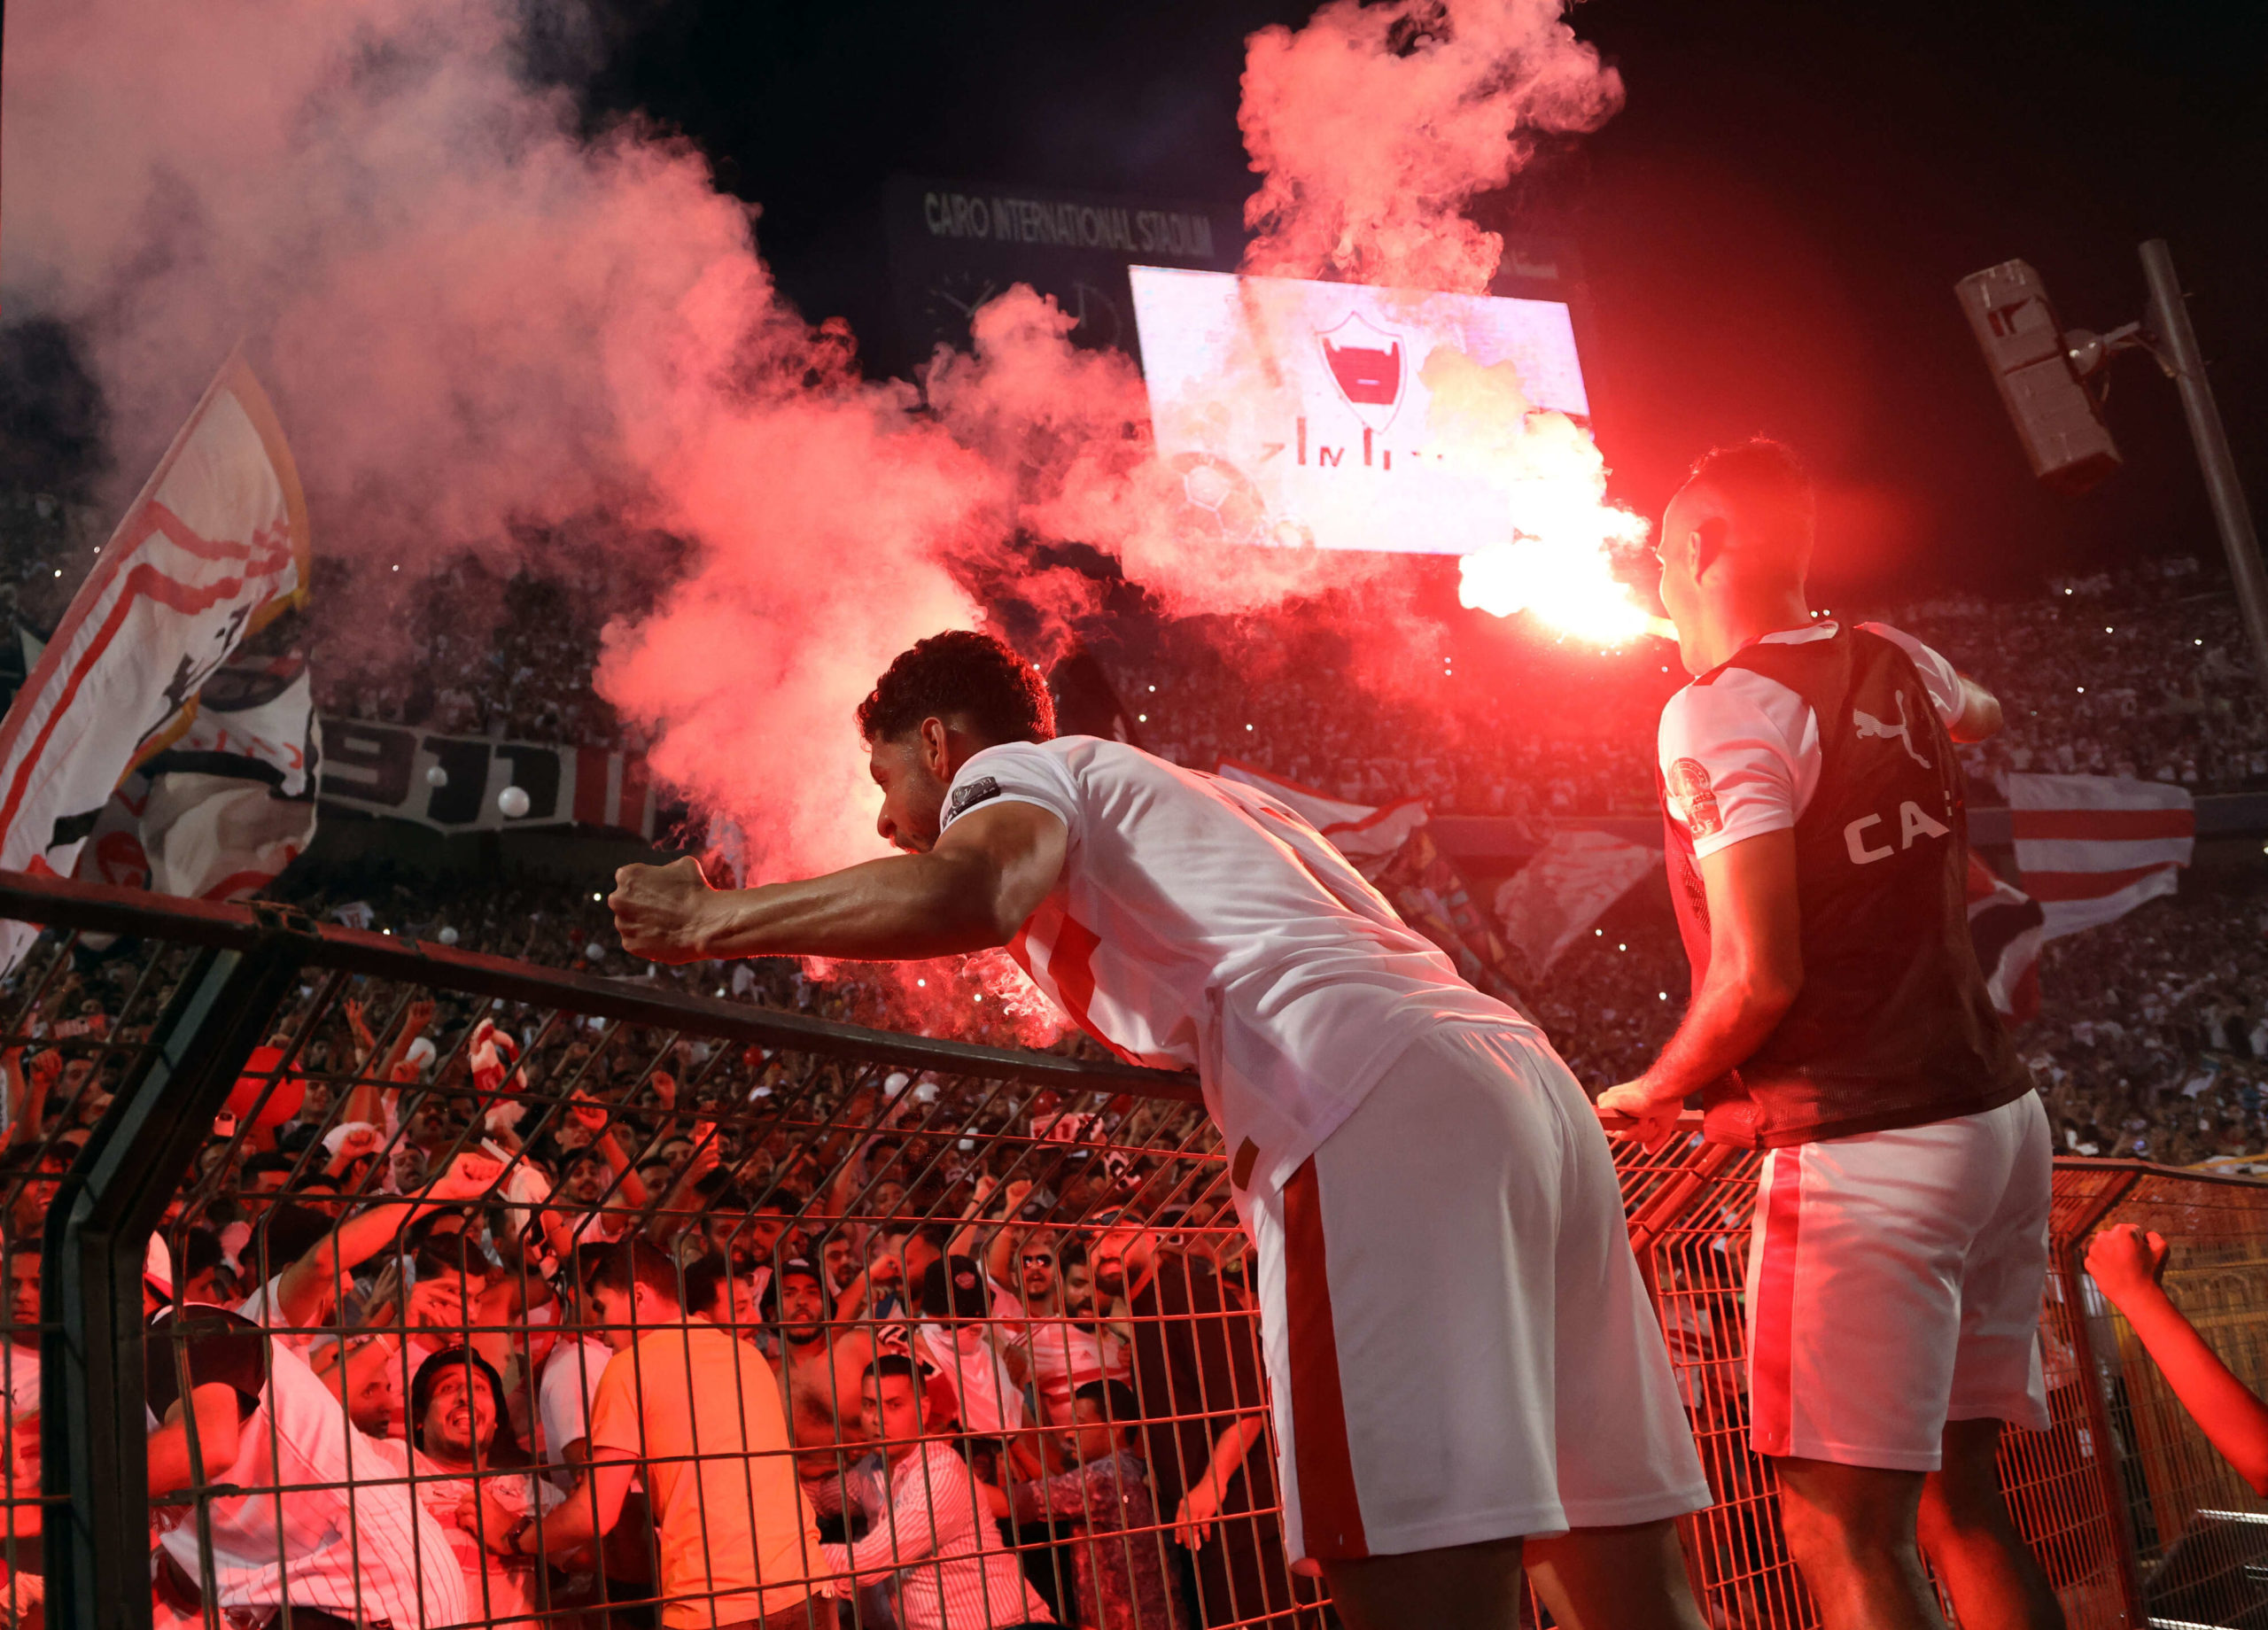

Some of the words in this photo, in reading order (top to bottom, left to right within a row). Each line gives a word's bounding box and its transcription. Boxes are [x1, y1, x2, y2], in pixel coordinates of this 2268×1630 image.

[924, 192, 990, 237] CAIRO
[991, 197, 1138, 252] INTERNATIONAL
[1136, 210, 1215, 257] STADIUM
[1844, 790, 1952, 865] CA
